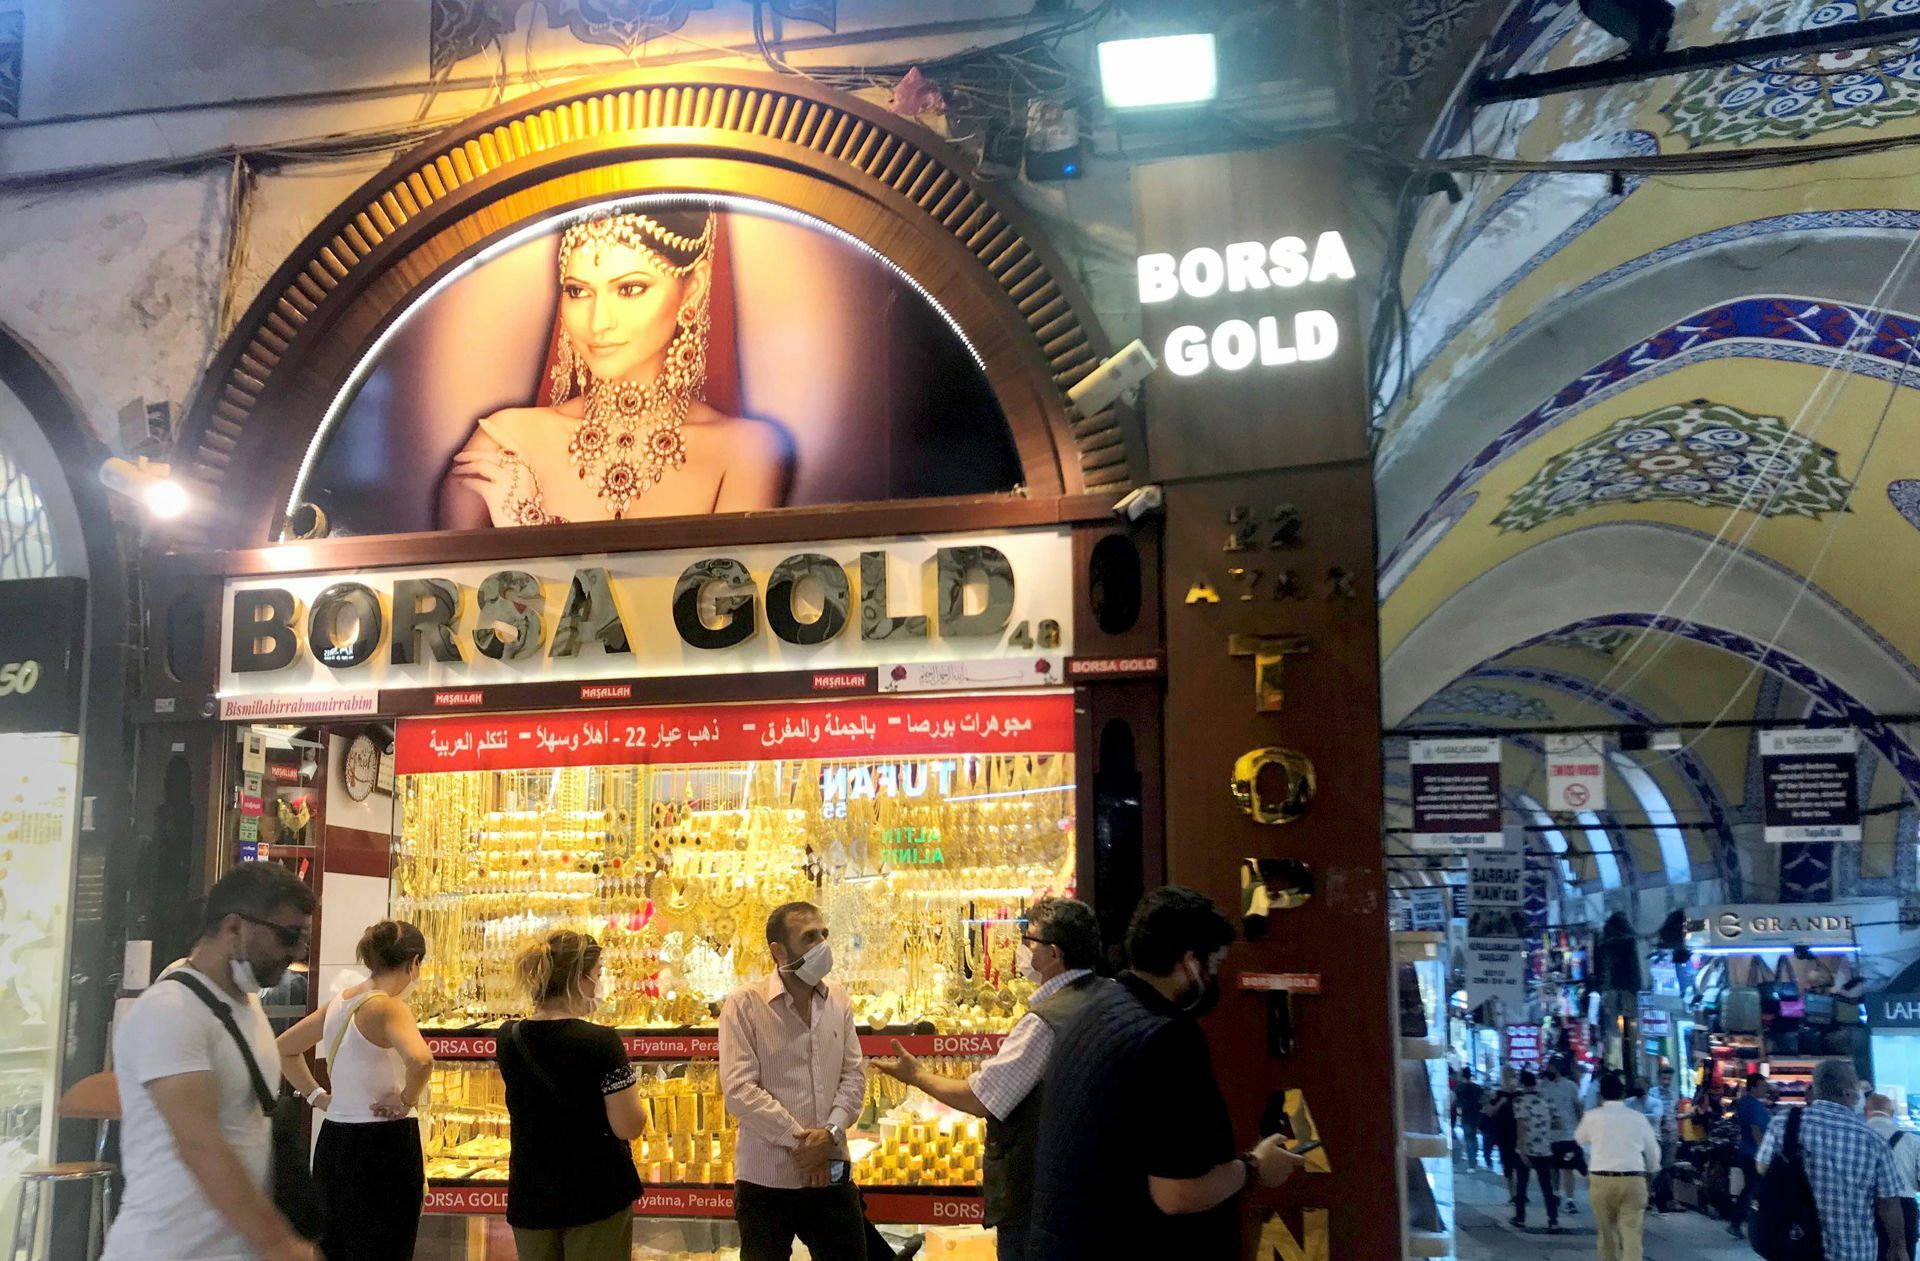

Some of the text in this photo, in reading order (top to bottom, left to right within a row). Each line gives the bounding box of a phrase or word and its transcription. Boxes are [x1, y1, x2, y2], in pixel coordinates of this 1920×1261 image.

[1137, 230, 1356, 303] BORSA
[1164, 310, 1339, 376] GOLD
[230, 545, 1017, 674] BORSA GOLD
[1008, 619, 1060, 650] 48
[1072, 659, 1156, 673] BORSA GOLD
[0, 660, 39, 696] 50
[814, 675, 865, 688] MAŞALLAH
[436, 692, 482, 705] MAŞALLAH
[583, 686, 631, 699] MAŞALLAH
[651, 724, 682, 749] عيار
[687, 718, 719, 742] ذهب
[825, 714, 876, 737] بالجملة
[907, 716, 956, 738] بورصا
[960, 714, 1031, 737] مجوهرات
[429, 730, 472, 756] العربية
[477, 730, 508, 757] نتكلم
[625, 727, 646, 747] 22
[1750, 915, 1852, 933] GRANDE
[428, 1040, 497, 1054] ORSA GO
[633, 1039, 688, 1054] Fiyatına,
[691, 1039, 719, 1051] Pera
[933, 1037, 992, 1052] BORSA
[424, 1193, 465, 1206] ORSA
[688, 1194, 733, 1207] Perake
